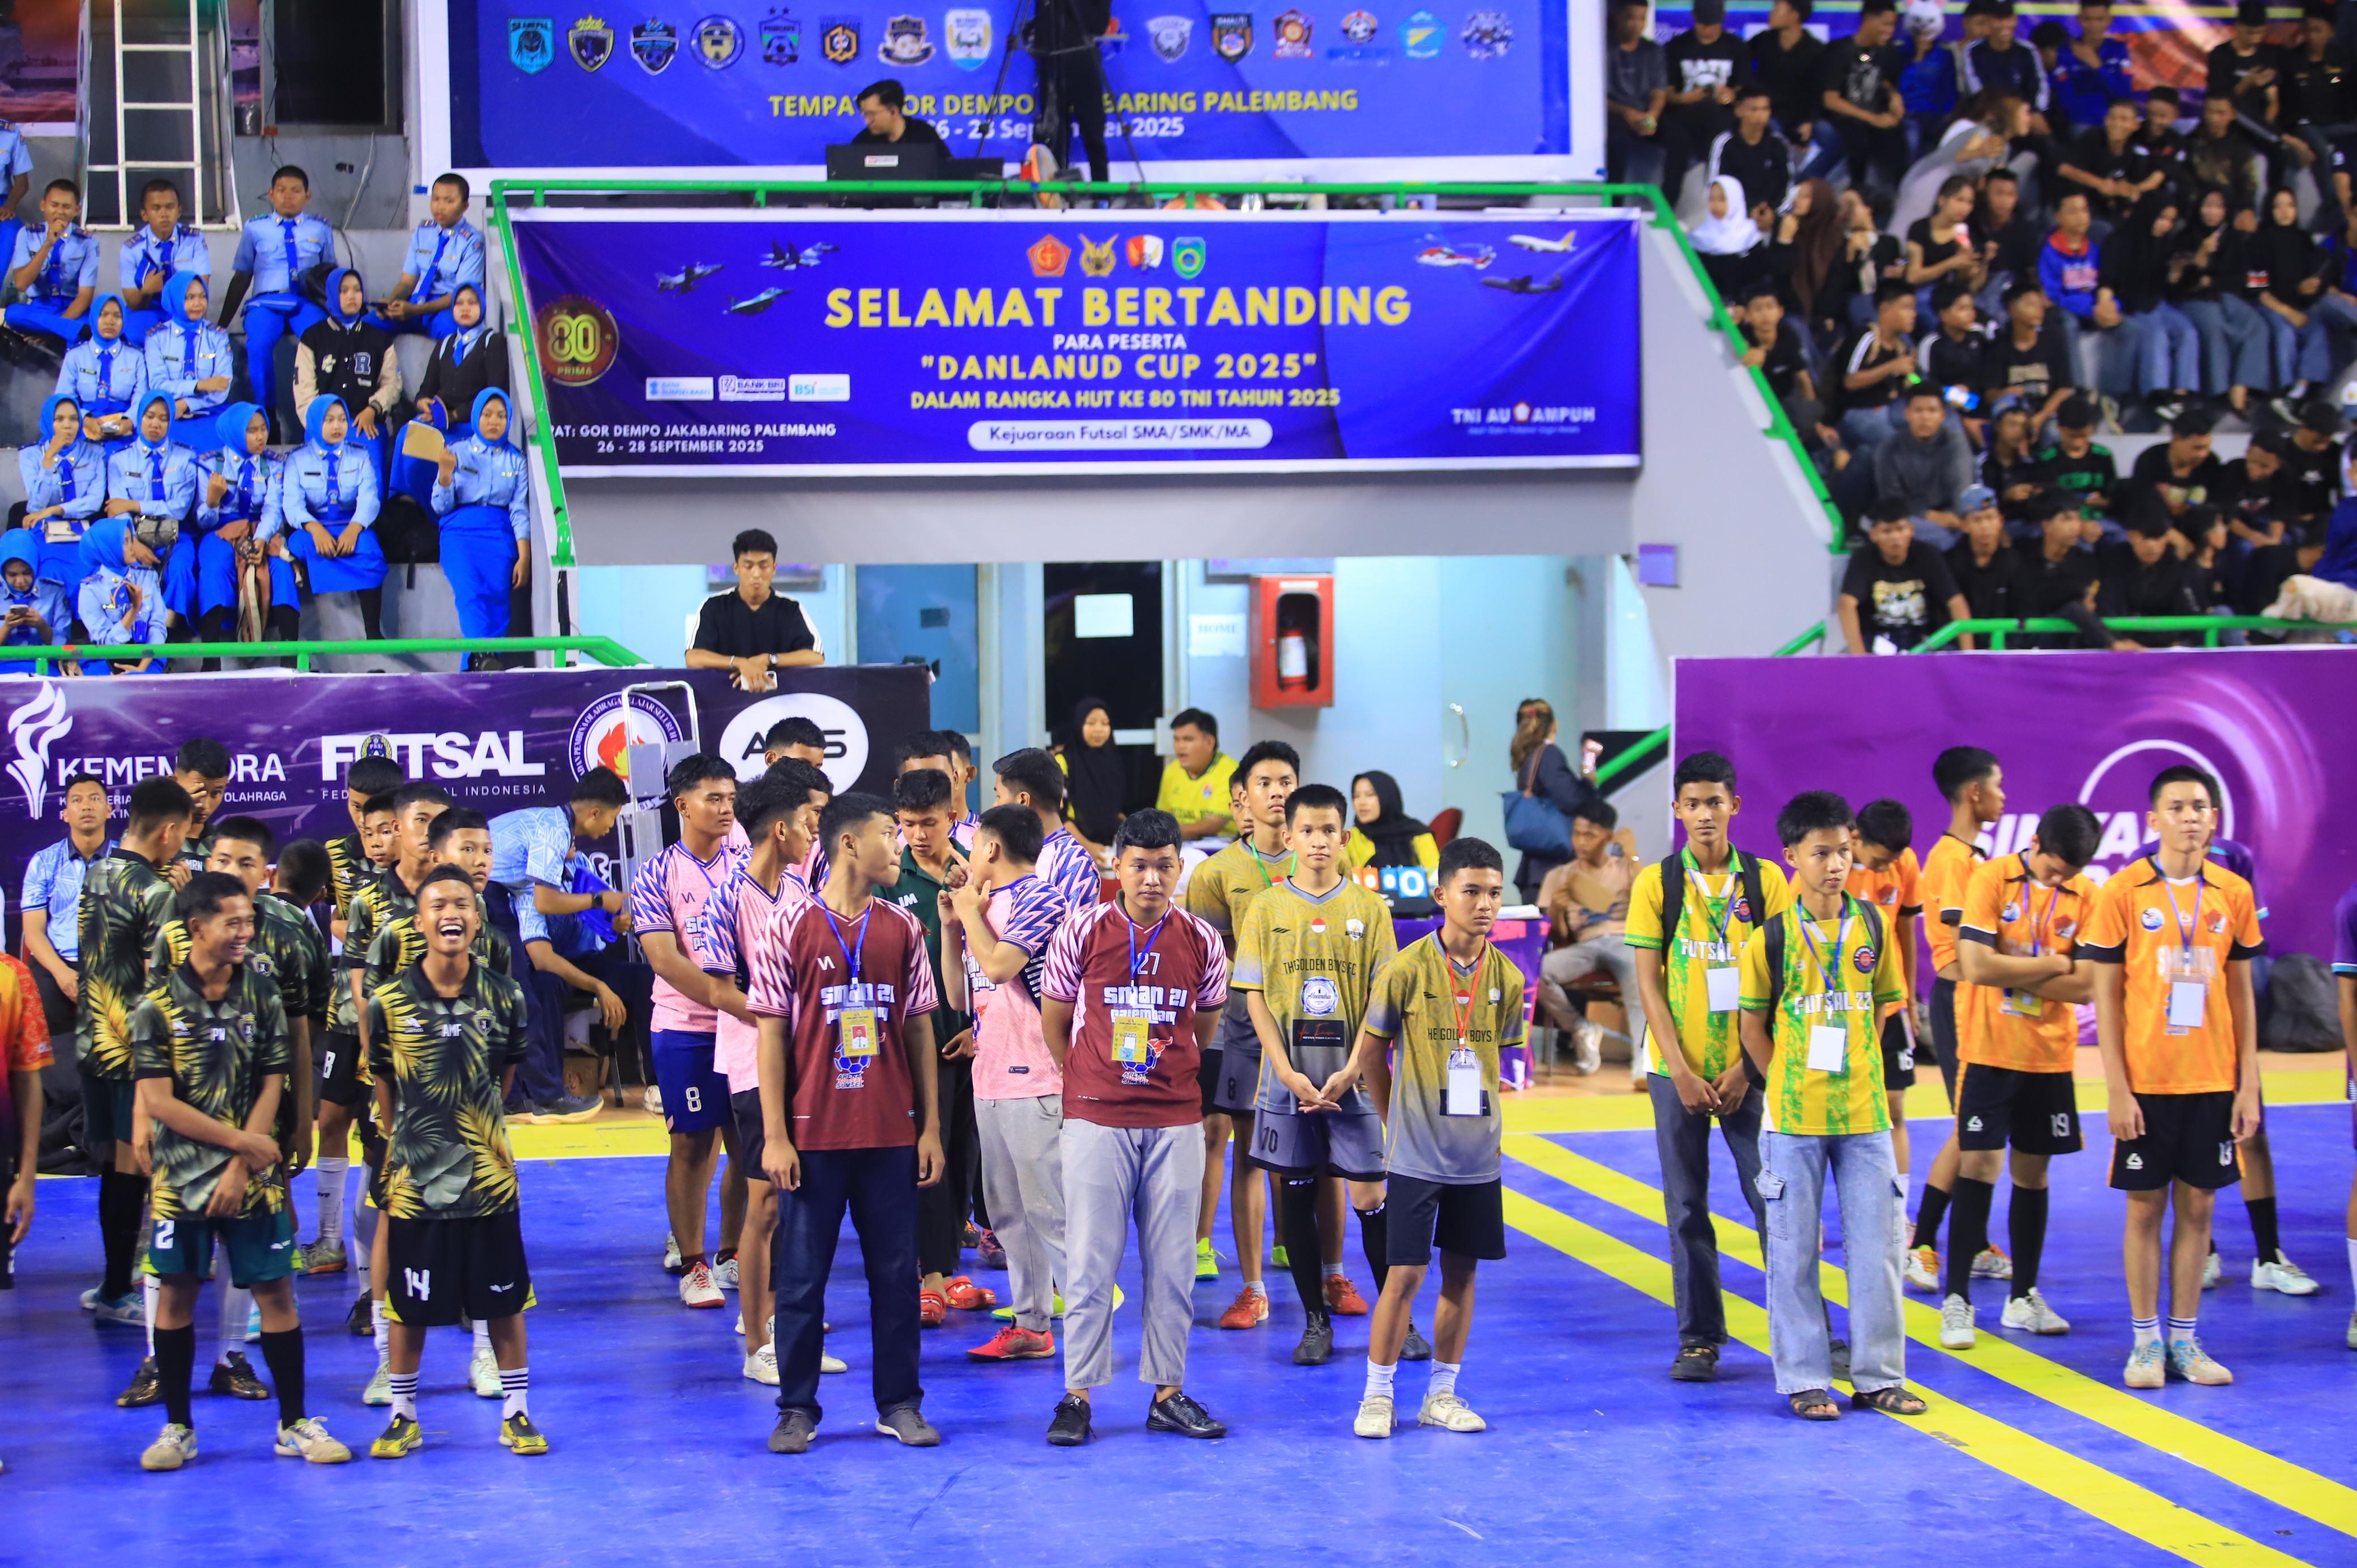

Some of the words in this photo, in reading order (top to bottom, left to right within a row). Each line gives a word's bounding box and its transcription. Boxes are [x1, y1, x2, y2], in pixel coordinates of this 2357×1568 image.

[768, 95, 856, 116] TEMPA
[902, 94, 938, 116] OR
[945, 94, 1035, 115] DEMPO
[1204, 90, 1358, 112] PALEMBANG
[1132, 117, 1185, 137] 2025
[824, 288, 1063, 328] SELAMAT
[1083, 286, 1411, 327] BERTANDING
[1053, 334, 1105, 351] PARA
[1108, 333, 1188, 351] PESERTA
[557, 366, 593, 376] PRIMA
[921, 355, 1122, 380] "DANLANUD
[1135, 354, 1201, 380] CUP
[1215, 353, 1317, 379] 2025"
[911, 391, 981, 409] DALAM
[985, 391, 1071, 409] RANGKA
[1075, 390, 1114, 408] HUT
[1120, 390, 1145, 408] KE
[1148, 390, 1176, 408] 80
[1179, 389, 1212, 407] TNI
[1216, 389, 1284, 407] TAHUN
[1288, 388, 1341, 407] 2025
[1451, 407, 1481, 424] TNI
[1486, 407, 1511, 424] AU
[1532, 406, 1596, 423] AMPUH
[580, 425, 610, 437] GOR
[614, 425, 661, 437] DEMPO
[664, 424, 751, 437] JAKABARING
[755, 424, 837, 437] PALEMBANG
[990, 426, 1075, 444] Kejuaraan
[1080, 425, 1127, 440] Futsal
[1134, 424, 1251, 440] SMA/SMK/MA
[598, 441, 615, 453] 26
[629, 441, 645, 453] 28
[650, 440, 725, 453] SEPTEMBER
[728, 440, 764, 453] 2025
[224, 791, 287, 802] OLAHRAGA
[466, 784, 546, 797] INDONESIA
[1137, 952, 1161, 975] 27
[1295, 958, 1326, 971] GOLDEN
[1169, 988, 1188, 1008] 21
[212, 1028, 226, 1041] PN
[443, 1024, 462, 1037] AMF
[1470, 1030, 1492, 1042] BOYS
[686, 1086, 702, 1113] 8
[2050, 1112, 2070, 1137] 19
[1261, 1126, 1279, 1153] 10
[155, 1220, 175, 1249] 2
[404, 1267, 430, 1301] 14
